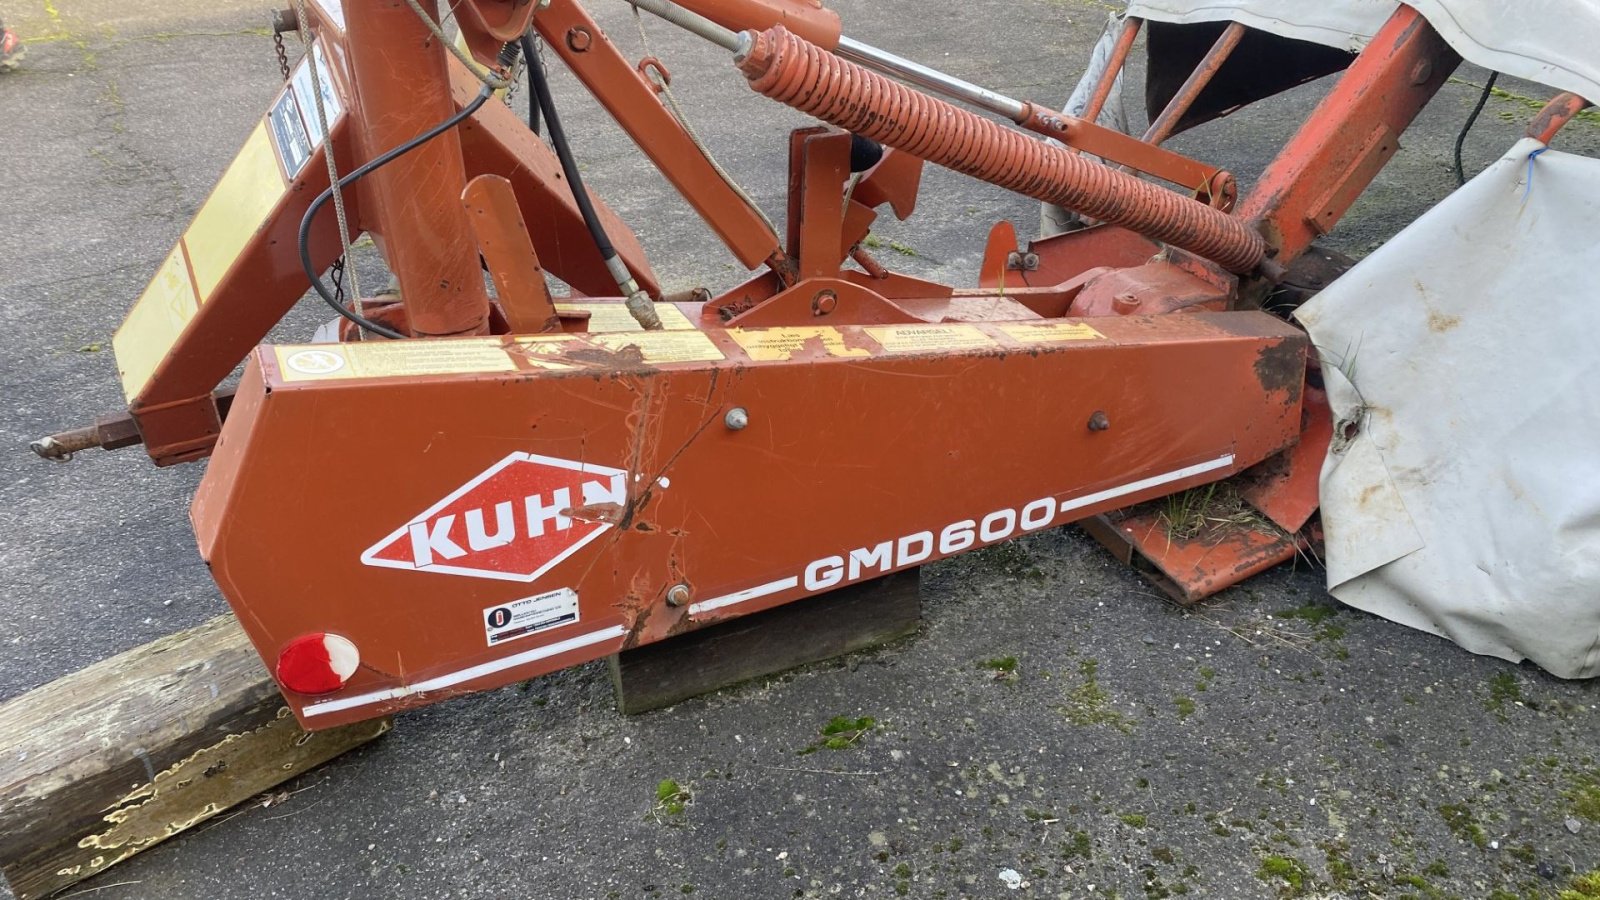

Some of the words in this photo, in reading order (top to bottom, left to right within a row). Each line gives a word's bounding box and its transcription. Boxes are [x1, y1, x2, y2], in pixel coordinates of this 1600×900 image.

[408, 472, 627, 568] KUHN
[804, 496, 1057, 592] GMD600
[511, 600, 532, 608] OTTO
[534, 591, 562, 602] JENSEN
